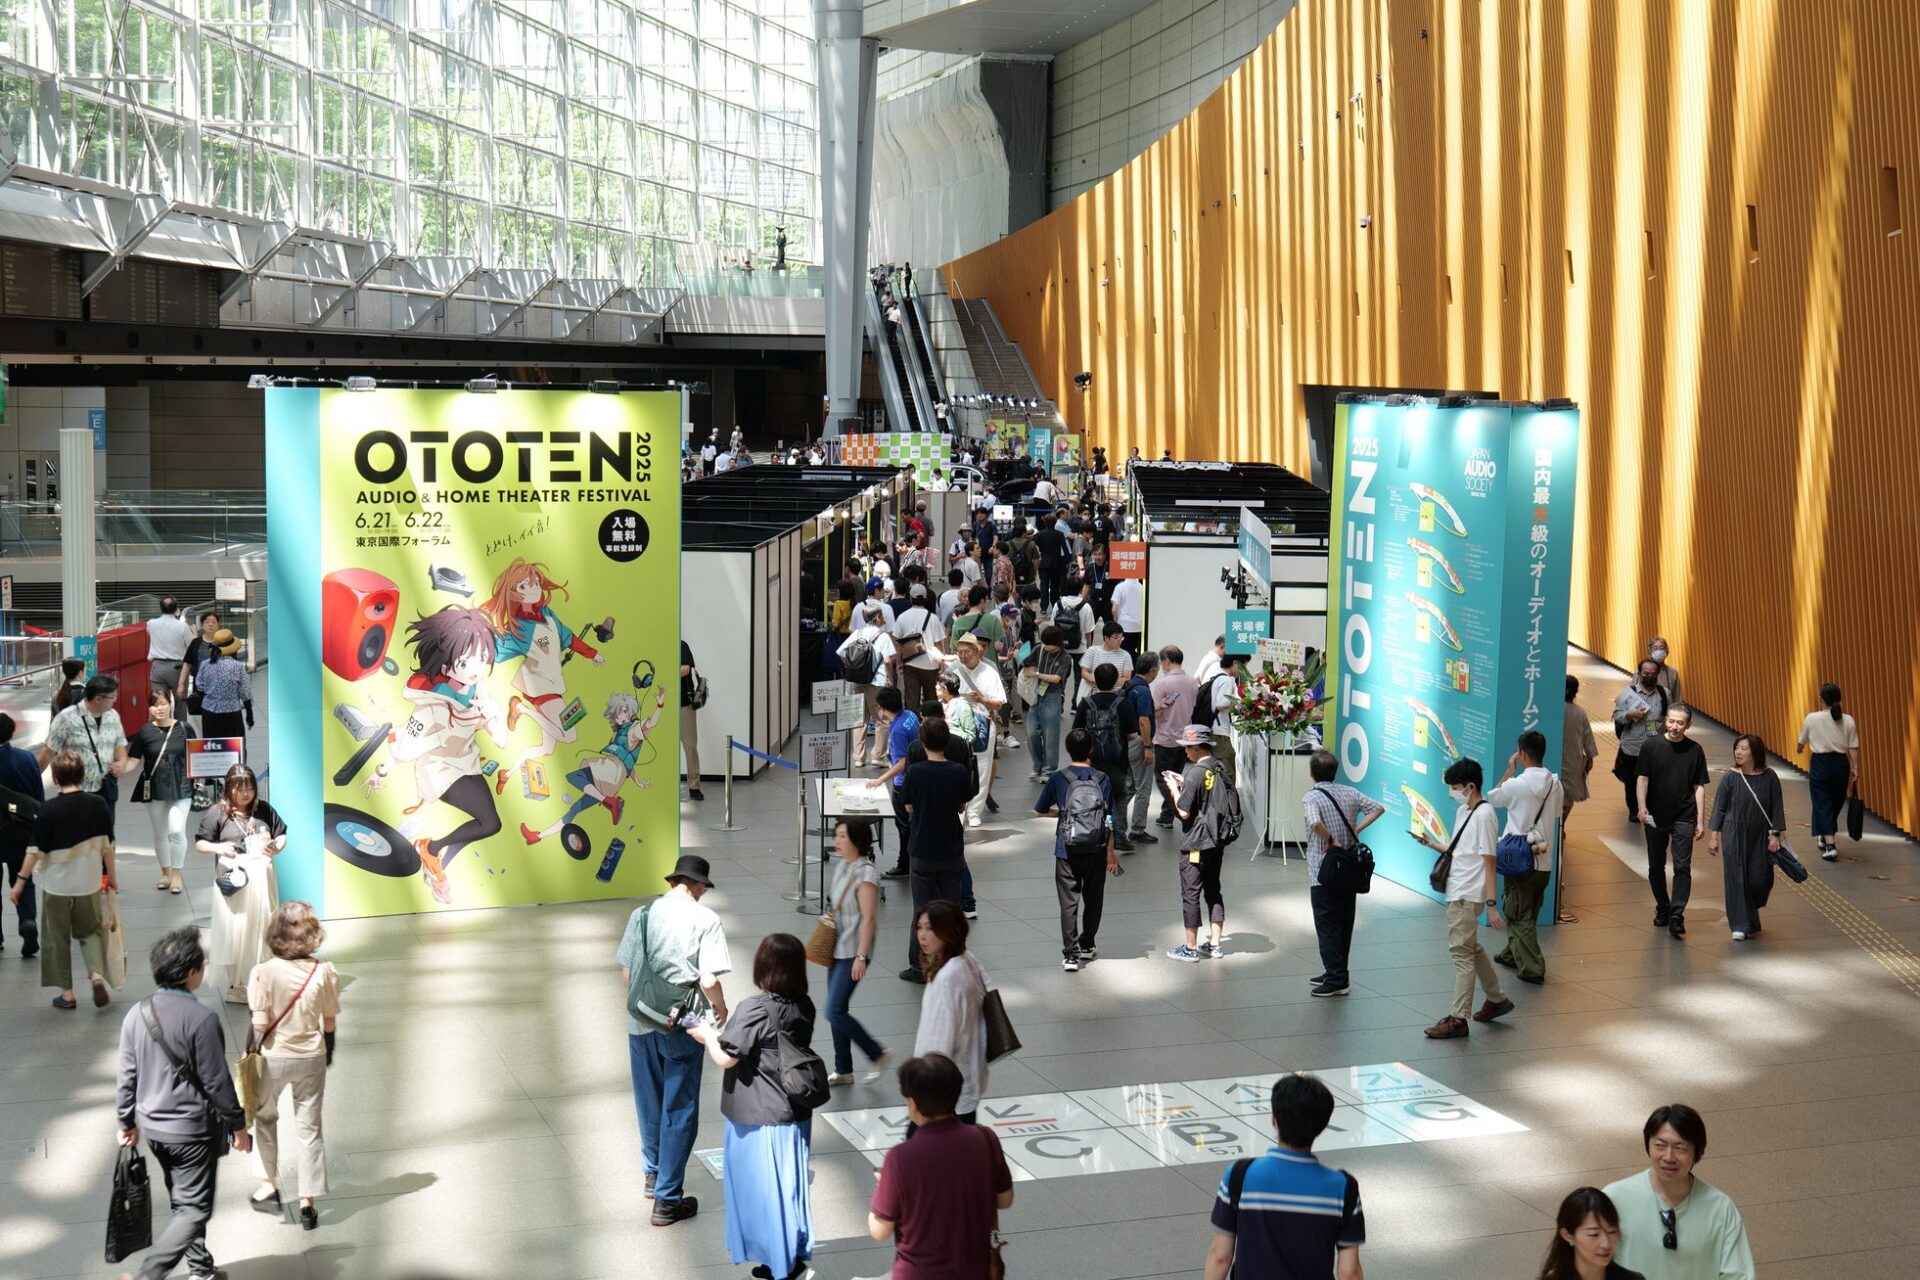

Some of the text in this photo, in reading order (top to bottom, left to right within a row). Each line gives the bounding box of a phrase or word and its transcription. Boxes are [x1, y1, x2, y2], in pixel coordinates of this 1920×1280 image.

[1351, 436, 1379, 457] 2025
[1470, 447, 1491, 460] JAPAN
[354, 430, 632, 484] OTOTEN
[636, 432, 652, 483] 2025
[1463, 459, 1497, 479] AUDIO
[1465, 476, 1494, 493] SOCIETY
[356, 489, 651, 504] AUDIO & HOME THEATER FESTIVAL
[355, 511, 443, 529] 6.21 6.22
[611, 516, 636, 529] 入場
[355, 536, 451, 547] 東京国際フォーラム
[611, 530, 636, 542] 無料
[1120, 561, 1137, 570] 受付
[1231, 620, 1265, 632] 来場者
[1341, 460, 1379, 783] OTOTEN
[1237, 632, 1259, 644] 受付
[203, 741, 222, 751] dts
[1403, 1100, 1479, 1121] G
[1007, 1123, 1059, 1134] hall
[1168, 1122, 1239, 1146] B
[1024, 1135, 1094, 1159] C
